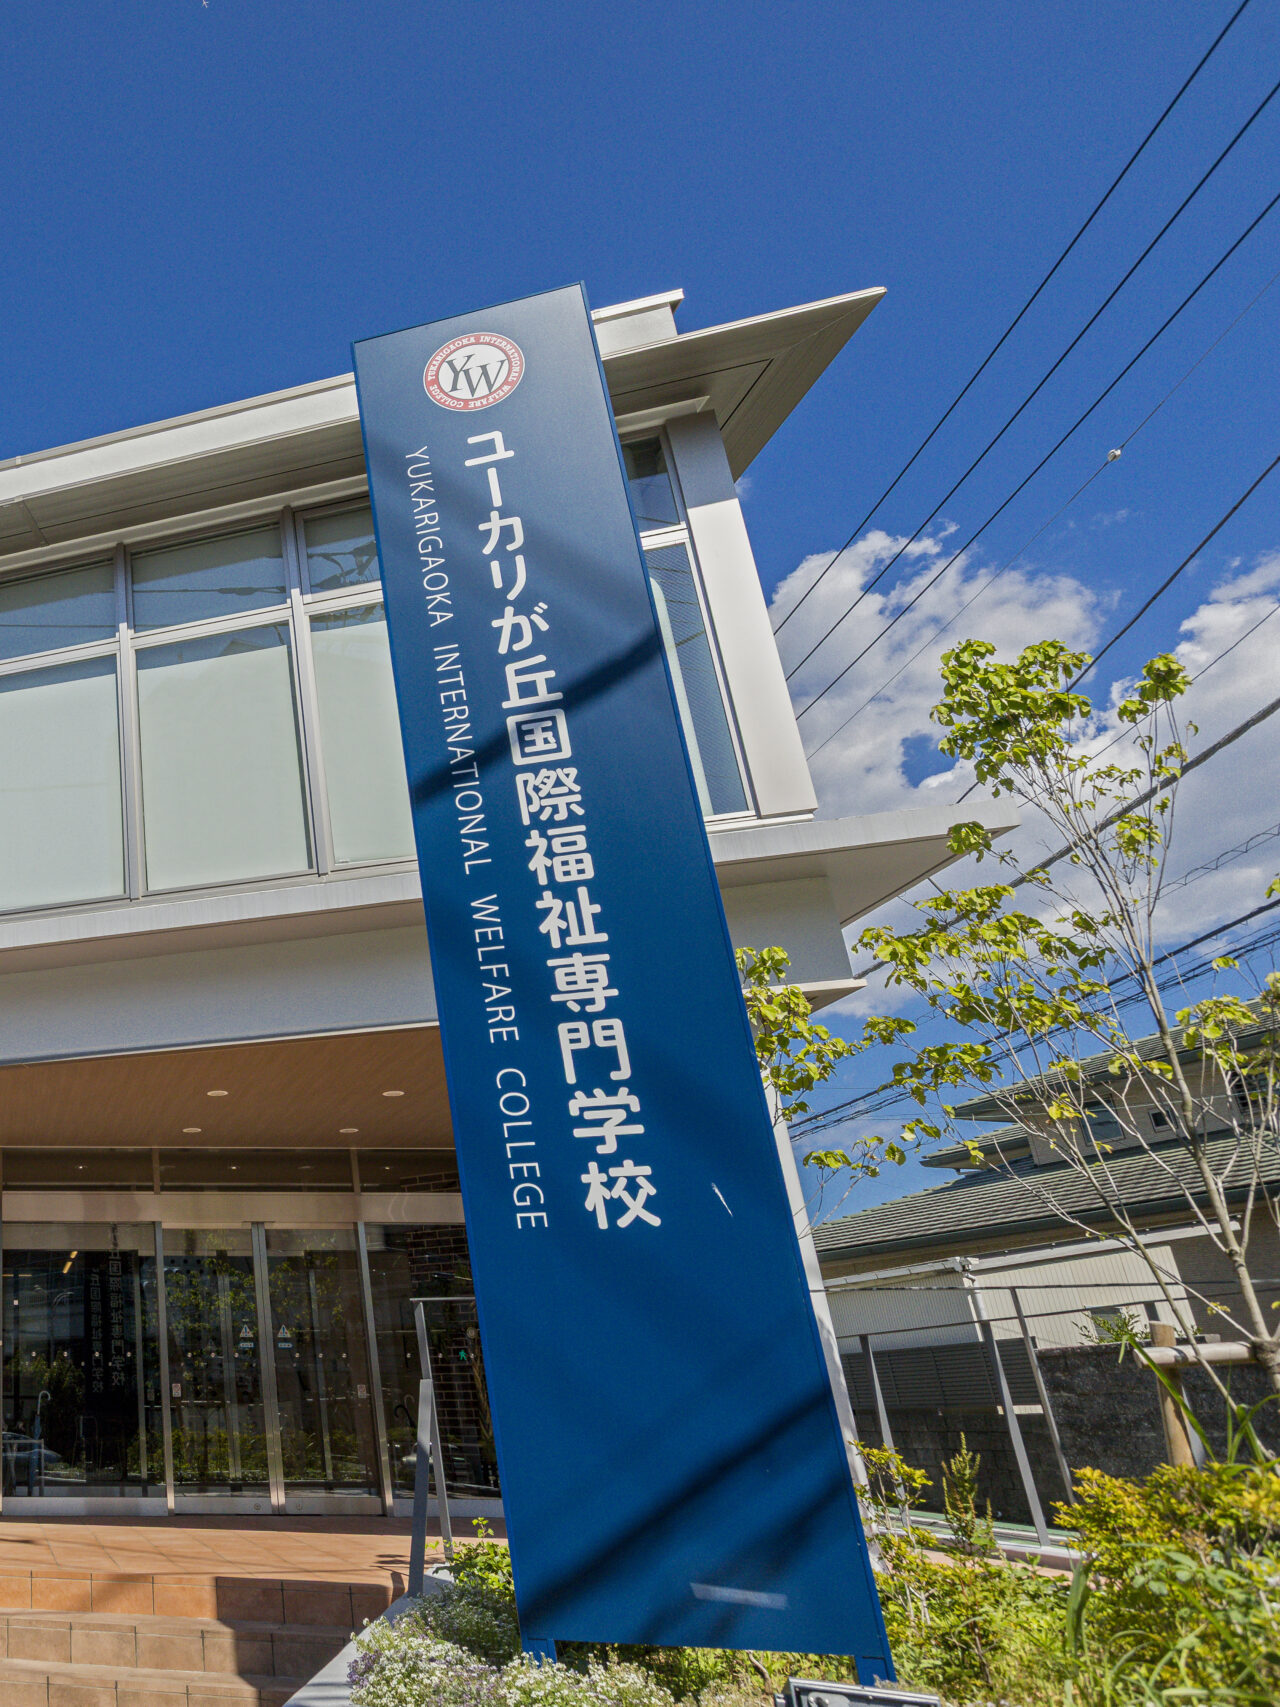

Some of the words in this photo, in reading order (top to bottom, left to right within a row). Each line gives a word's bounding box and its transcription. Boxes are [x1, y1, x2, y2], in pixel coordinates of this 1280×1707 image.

[428, 336, 476, 381] YUKARIGAOKA
[444, 353, 509, 398] YW
[480, 335, 521, 382] INTERNATIONAL
[429, 384, 464, 408] COLLEGE
[468, 384, 512, 408] WELFARE
[405, 445, 454, 628] YUKARIGAOKA
[433, 643, 493, 876] INTERNATIONAL
[470, 893, 520, 1044] WELFARE
[495, 1067, 549, 1230] COLLEGE
[464, 430, 662, 1230] ユーカリが丘国際福祉専門学校
